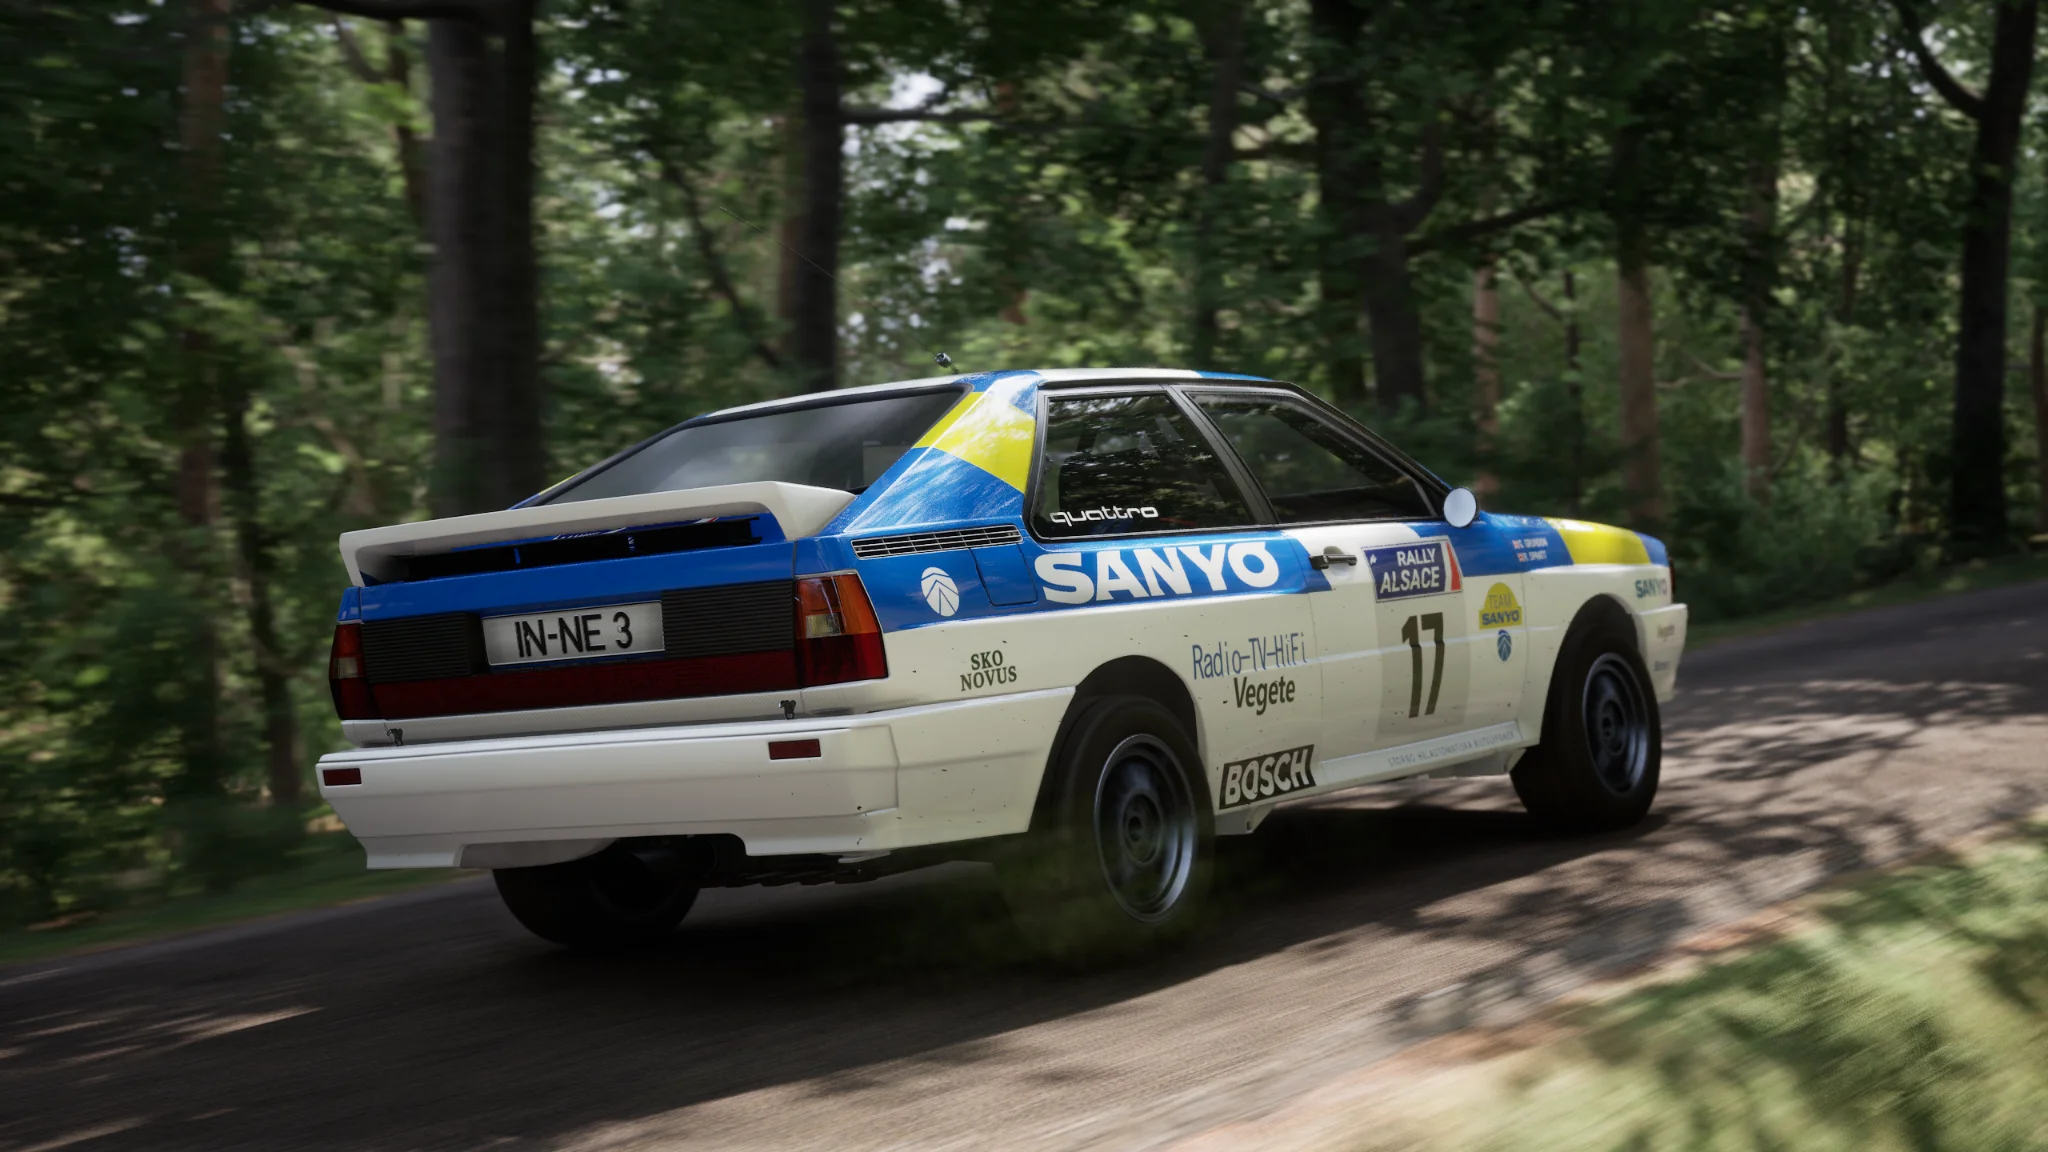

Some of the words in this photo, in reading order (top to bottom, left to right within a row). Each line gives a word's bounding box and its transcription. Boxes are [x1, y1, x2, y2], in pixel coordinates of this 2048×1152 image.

[1050, 505, 1159, 527] quattro
[1396, 548, 1436, 567] RALLY
[1034, 541, 1280, 605] SANYO
[1380, 566, 1440, 593] ALSACE
[1635, 578, 1668, 598] SANYO
[1488, 594, 1512, 609] TEAM
[1482, 610, 1520, 625] SANYO
[515, 614, 606, 658] IN-NE
[613, 611, 633, 649] 3
[970, 650, 1003, 671] SKO
[1402, 612, 1445, 718] 17
[960, 665, 1017, 691] NOVUS
[1234, 676, 1296, 715] Vegete
[1225, 748, 1310, 805] BOSCH
